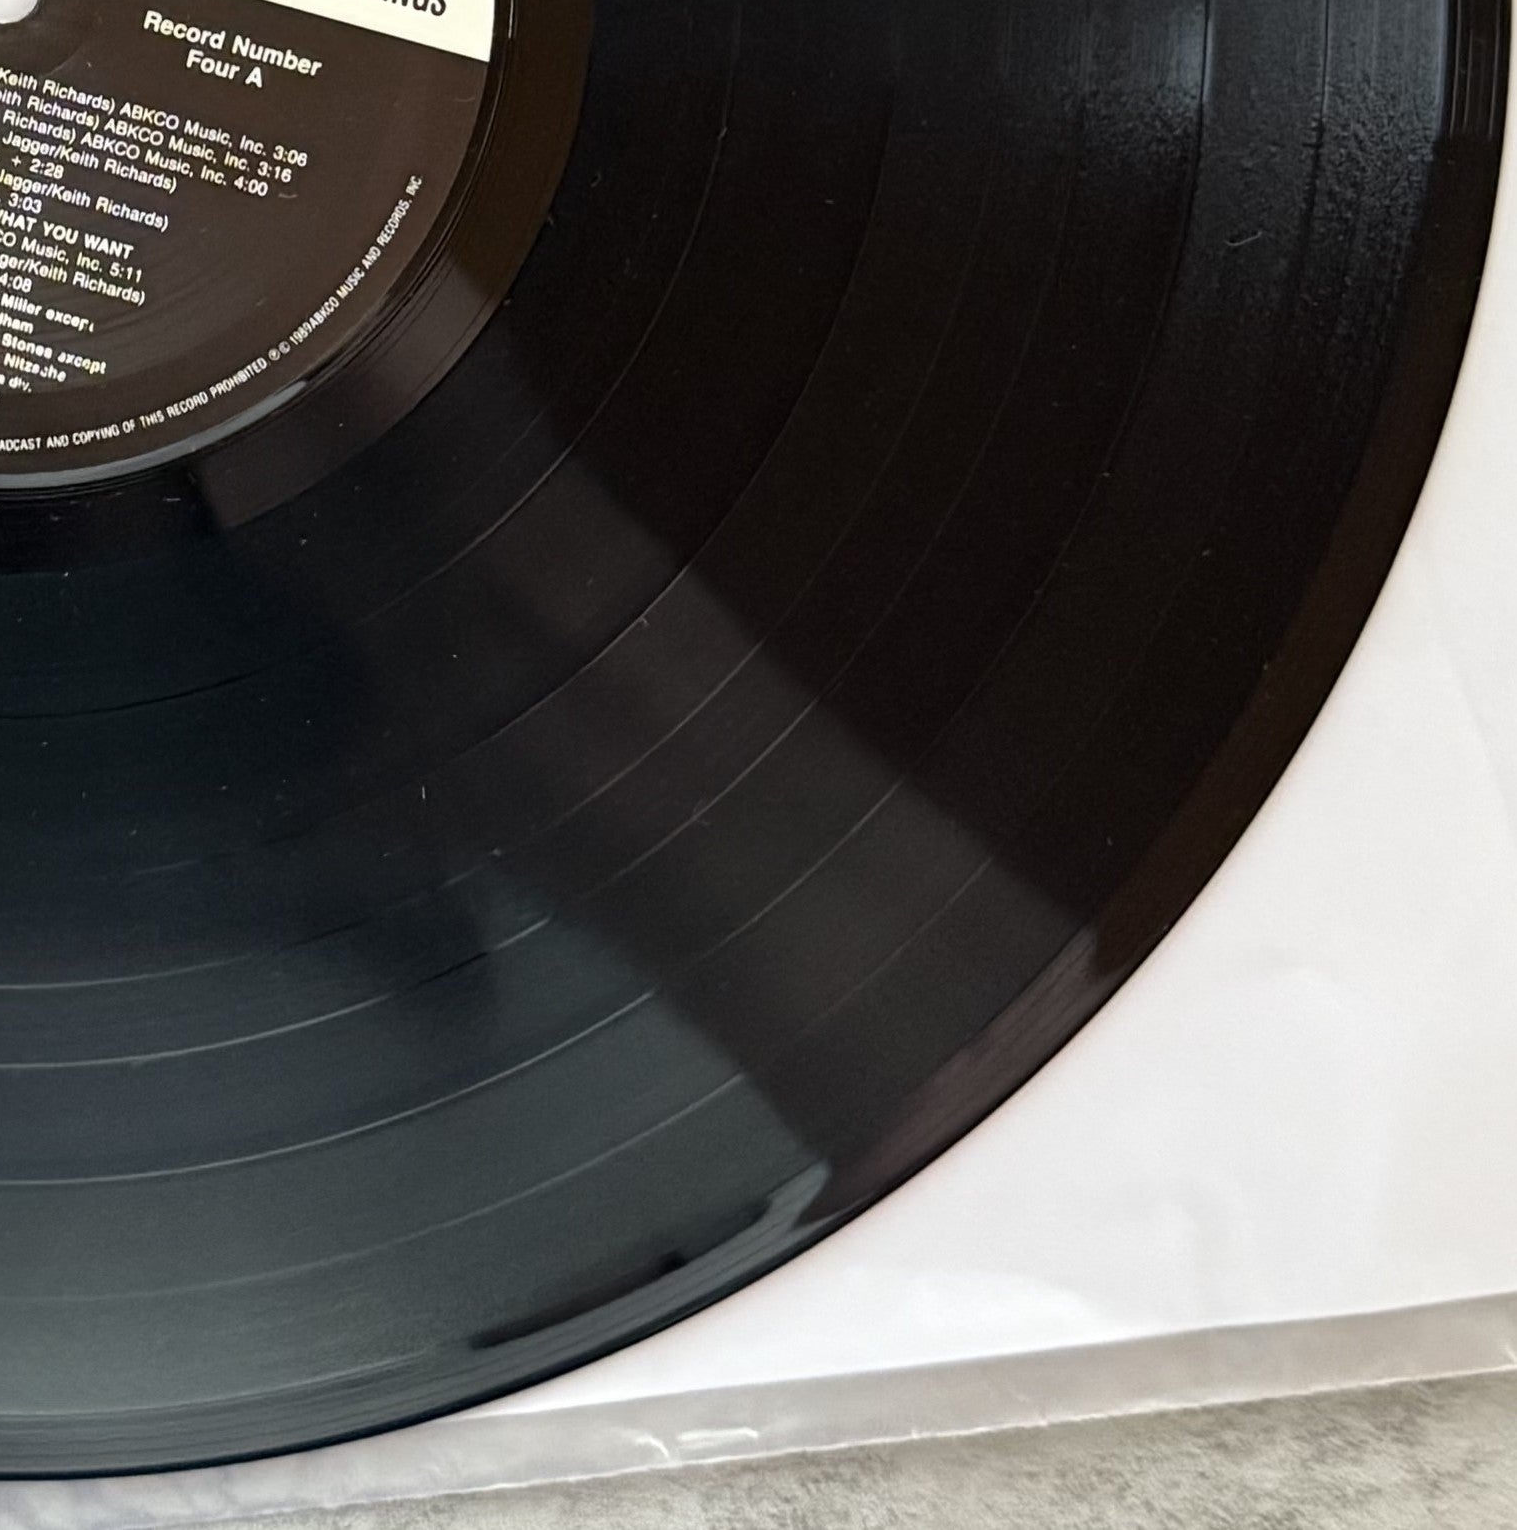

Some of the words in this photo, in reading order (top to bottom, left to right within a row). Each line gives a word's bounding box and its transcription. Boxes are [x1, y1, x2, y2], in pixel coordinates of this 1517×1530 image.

[143, 10, 226, 50] Record
[232, 35, 323, 77] Number
[186, 49, 240, 80] Four
[245, 66, 264, 88] A
[41, 78, 115, 115] Richards)
[118, 101, 179, 130] ABKCO
[239, 134, 266, 156] Inc.
[2, 108, 76, 145] Richards)
[79, 131, 140, 160] ABKCO
[200, 164, 226, 185] Inc.
[233, 175, 268, 196] 4:00
[26, 94, 99, 131] Richards)
[103, 117, 164, 146] ABKCO
[223, 150, 249, 171] Inc.
[257, 160, 292, 182] 3:16
[1, 130, 99, 169] Jagger/Keith
[103, 157, 177, 194] Richards)
[28, 157, 64, 179] 2:28
[7, 191, 42, 214] 3:03
[94, 195, 168, 232] Richards)
[42, 220, 79, 244] YOU
[84, 232, 134, 259] WANT
[75, 251, 102, 272] Inc.
[108, 261, 142, 283] 5:11
[71, 270, 145, 306] Richards)
